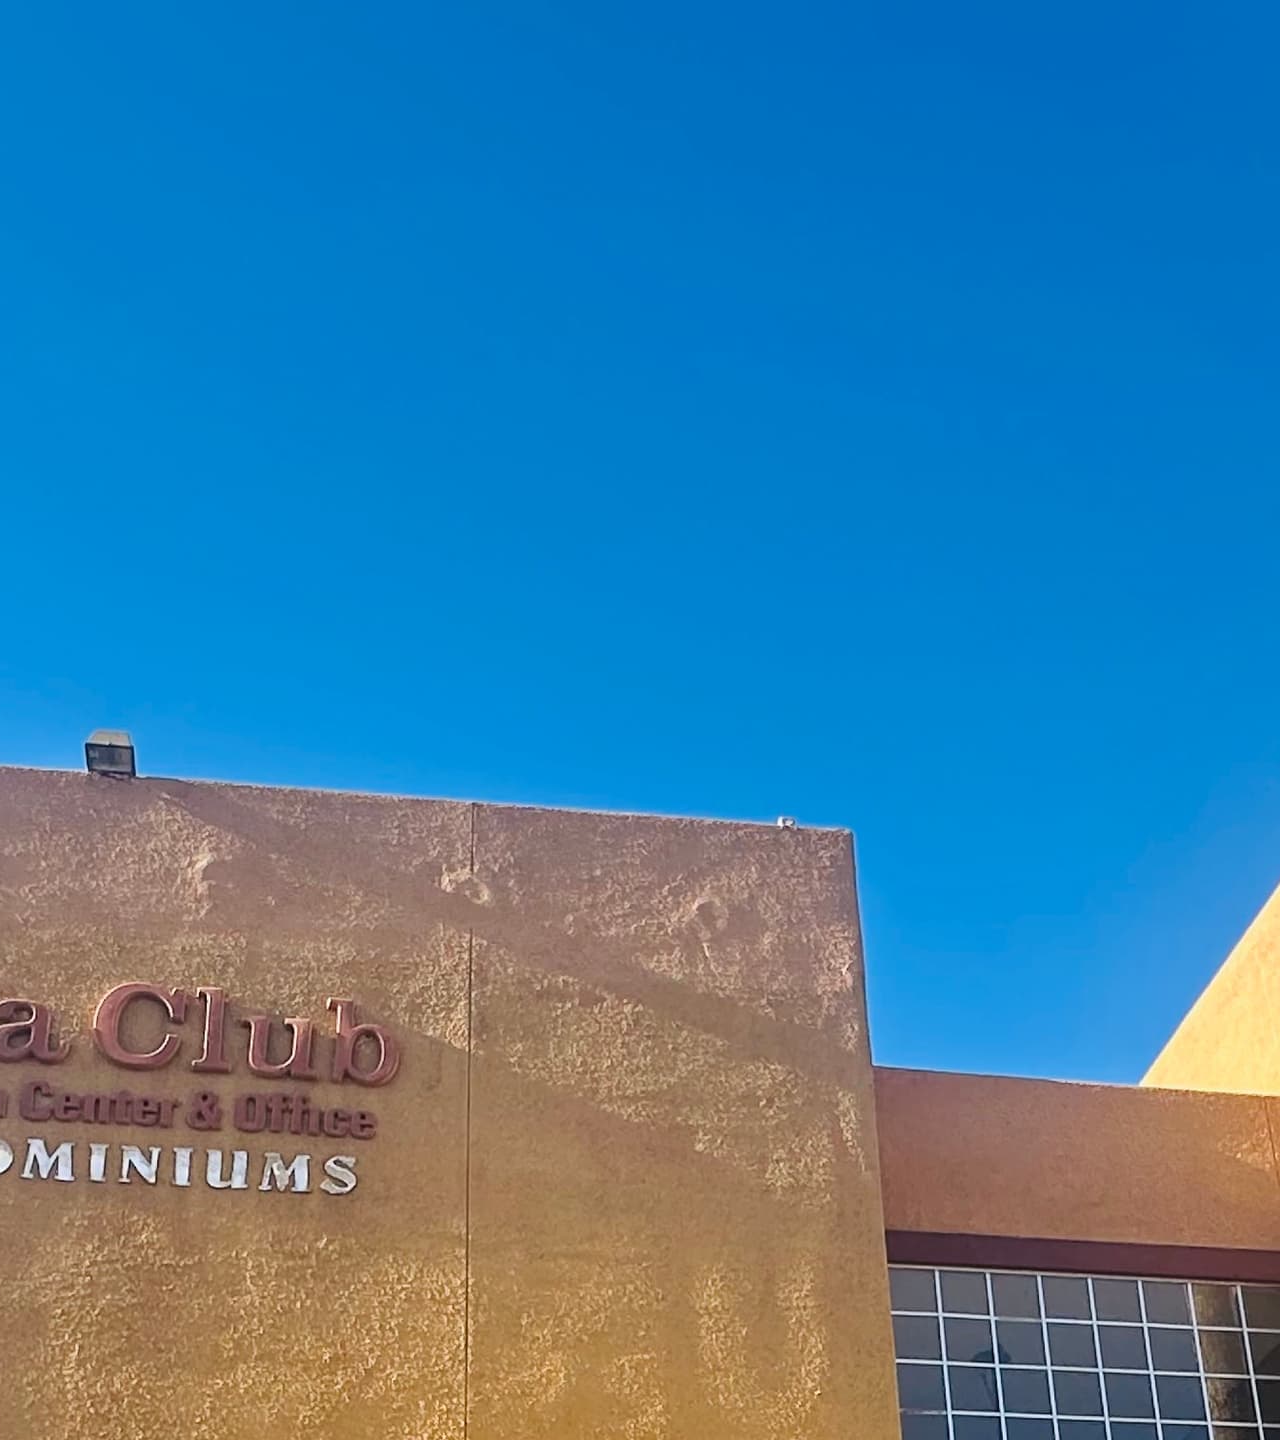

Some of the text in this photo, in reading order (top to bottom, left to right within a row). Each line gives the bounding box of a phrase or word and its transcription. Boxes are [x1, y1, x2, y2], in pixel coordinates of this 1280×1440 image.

[91, 981, 401, 1087] Club
[20, 1080, 179, 1130] Center
[186, 1091, 223, 1131] &
[233, 1090, 378, 1139] Office
